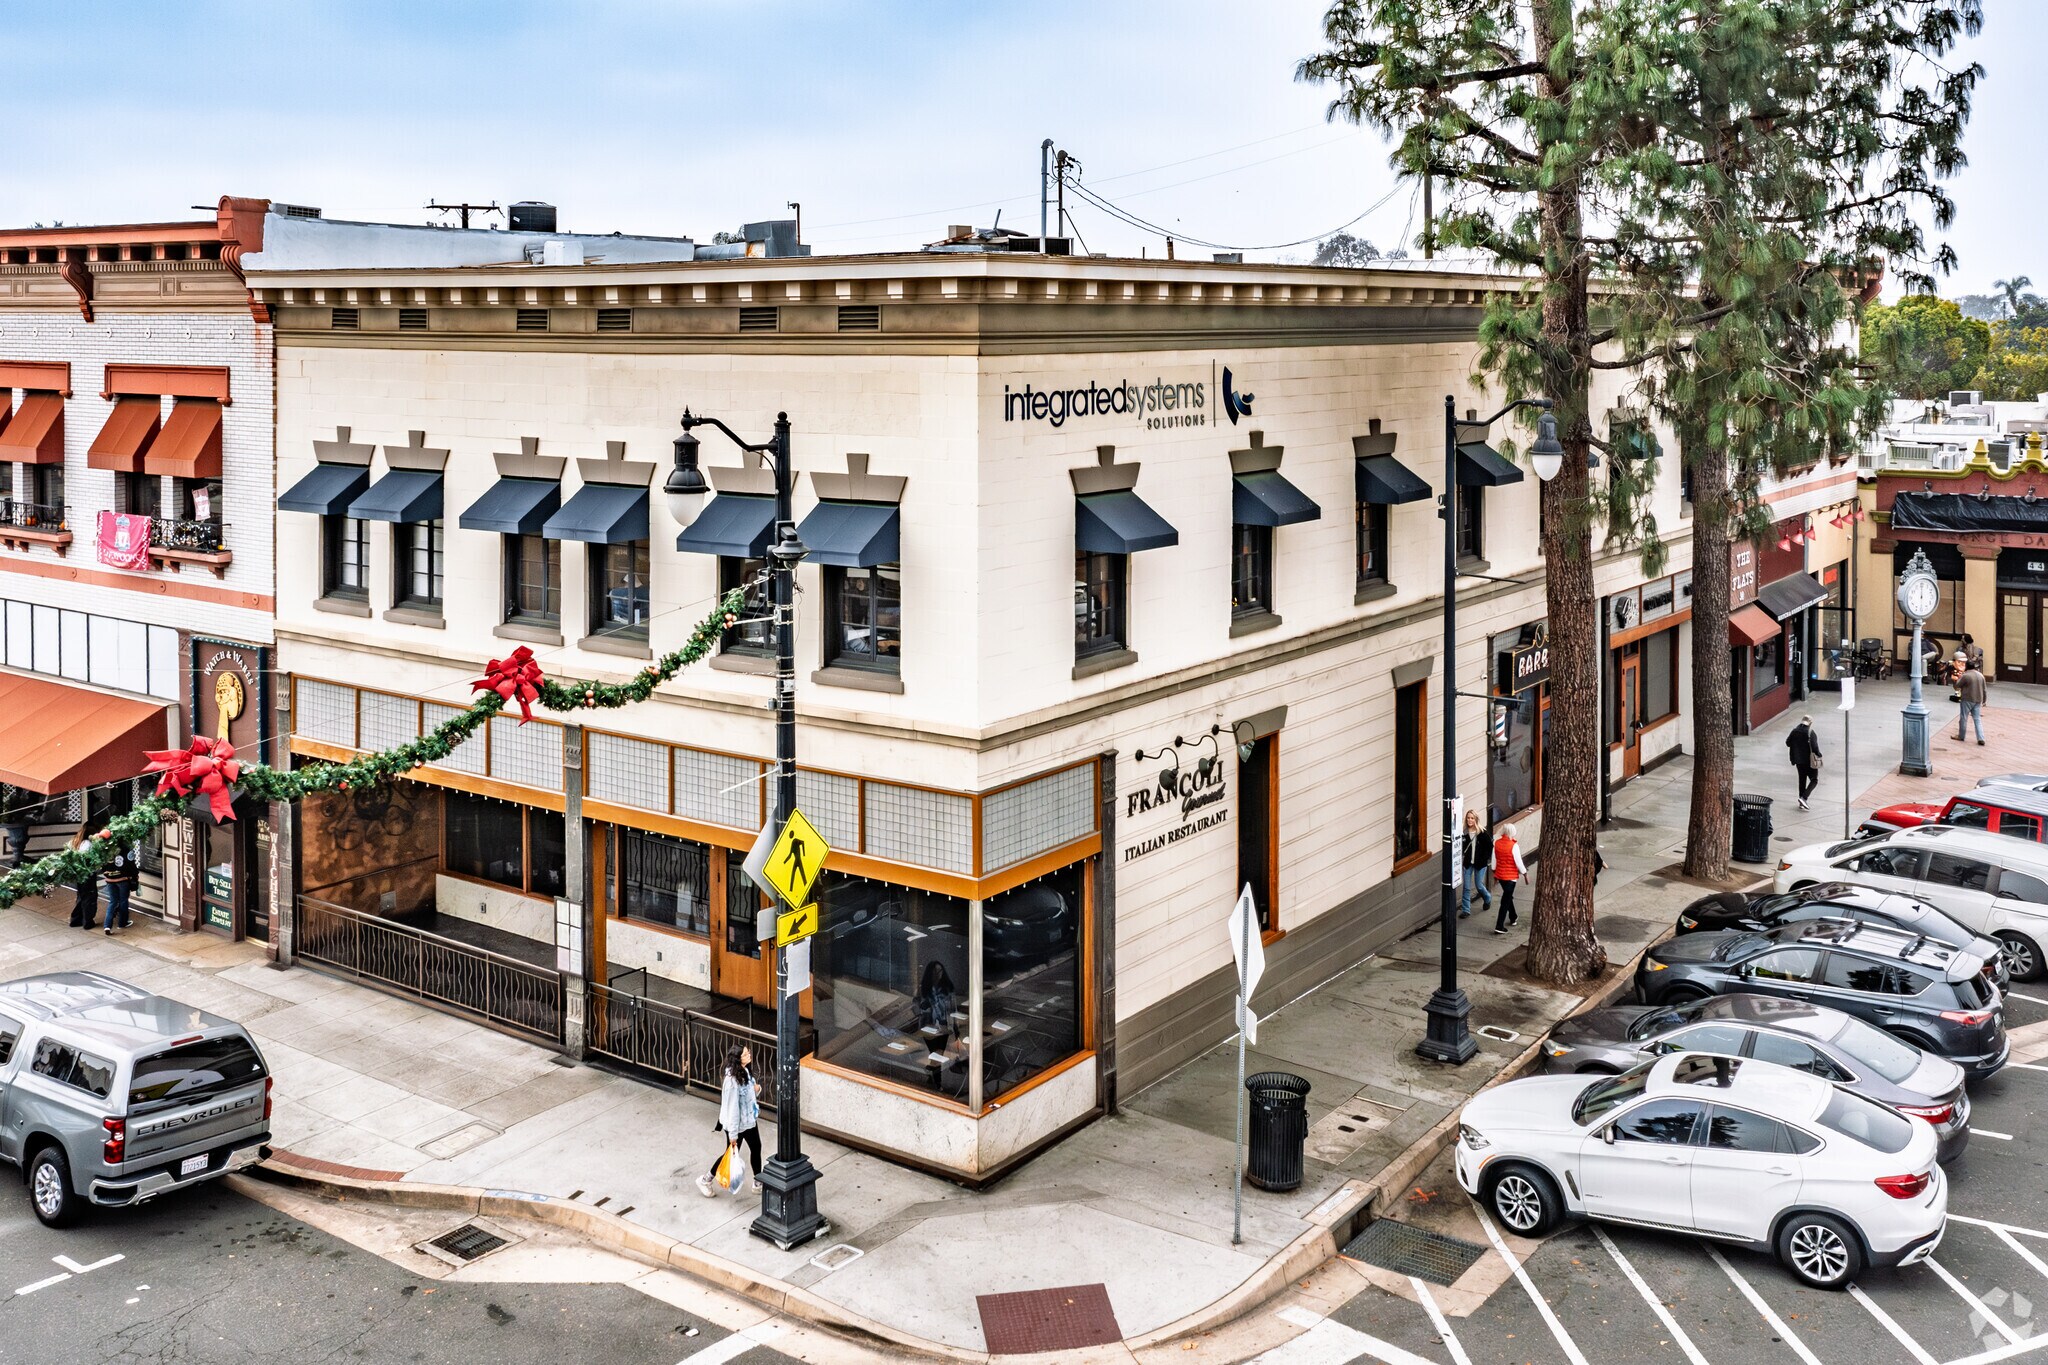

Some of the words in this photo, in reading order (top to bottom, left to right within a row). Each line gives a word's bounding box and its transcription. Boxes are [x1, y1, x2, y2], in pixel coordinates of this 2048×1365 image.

[1147, 414, 1205, 430] SOLUTIONS
[1736, 551, 1751, 568] THE
[1732, 571, 1755, 591] FLATS
[203, 651, 225, 676] WATCH
[226, 651, 232, 659] &
[233, 651, 254, 685] WARES
[1518, 649, 1549, 678] BARB
[1127, 761, 1224, 818] FRANCOLI
[183, 817, 196, 889] EWELRY
[1125, 834, 1165, 862] ITALIAN
[1168, 809, 1228, 844] RESTAURANT
[269, 832, 279, 915] WATCHES
[137, 1096, 258, 1136] CHEVROLET
